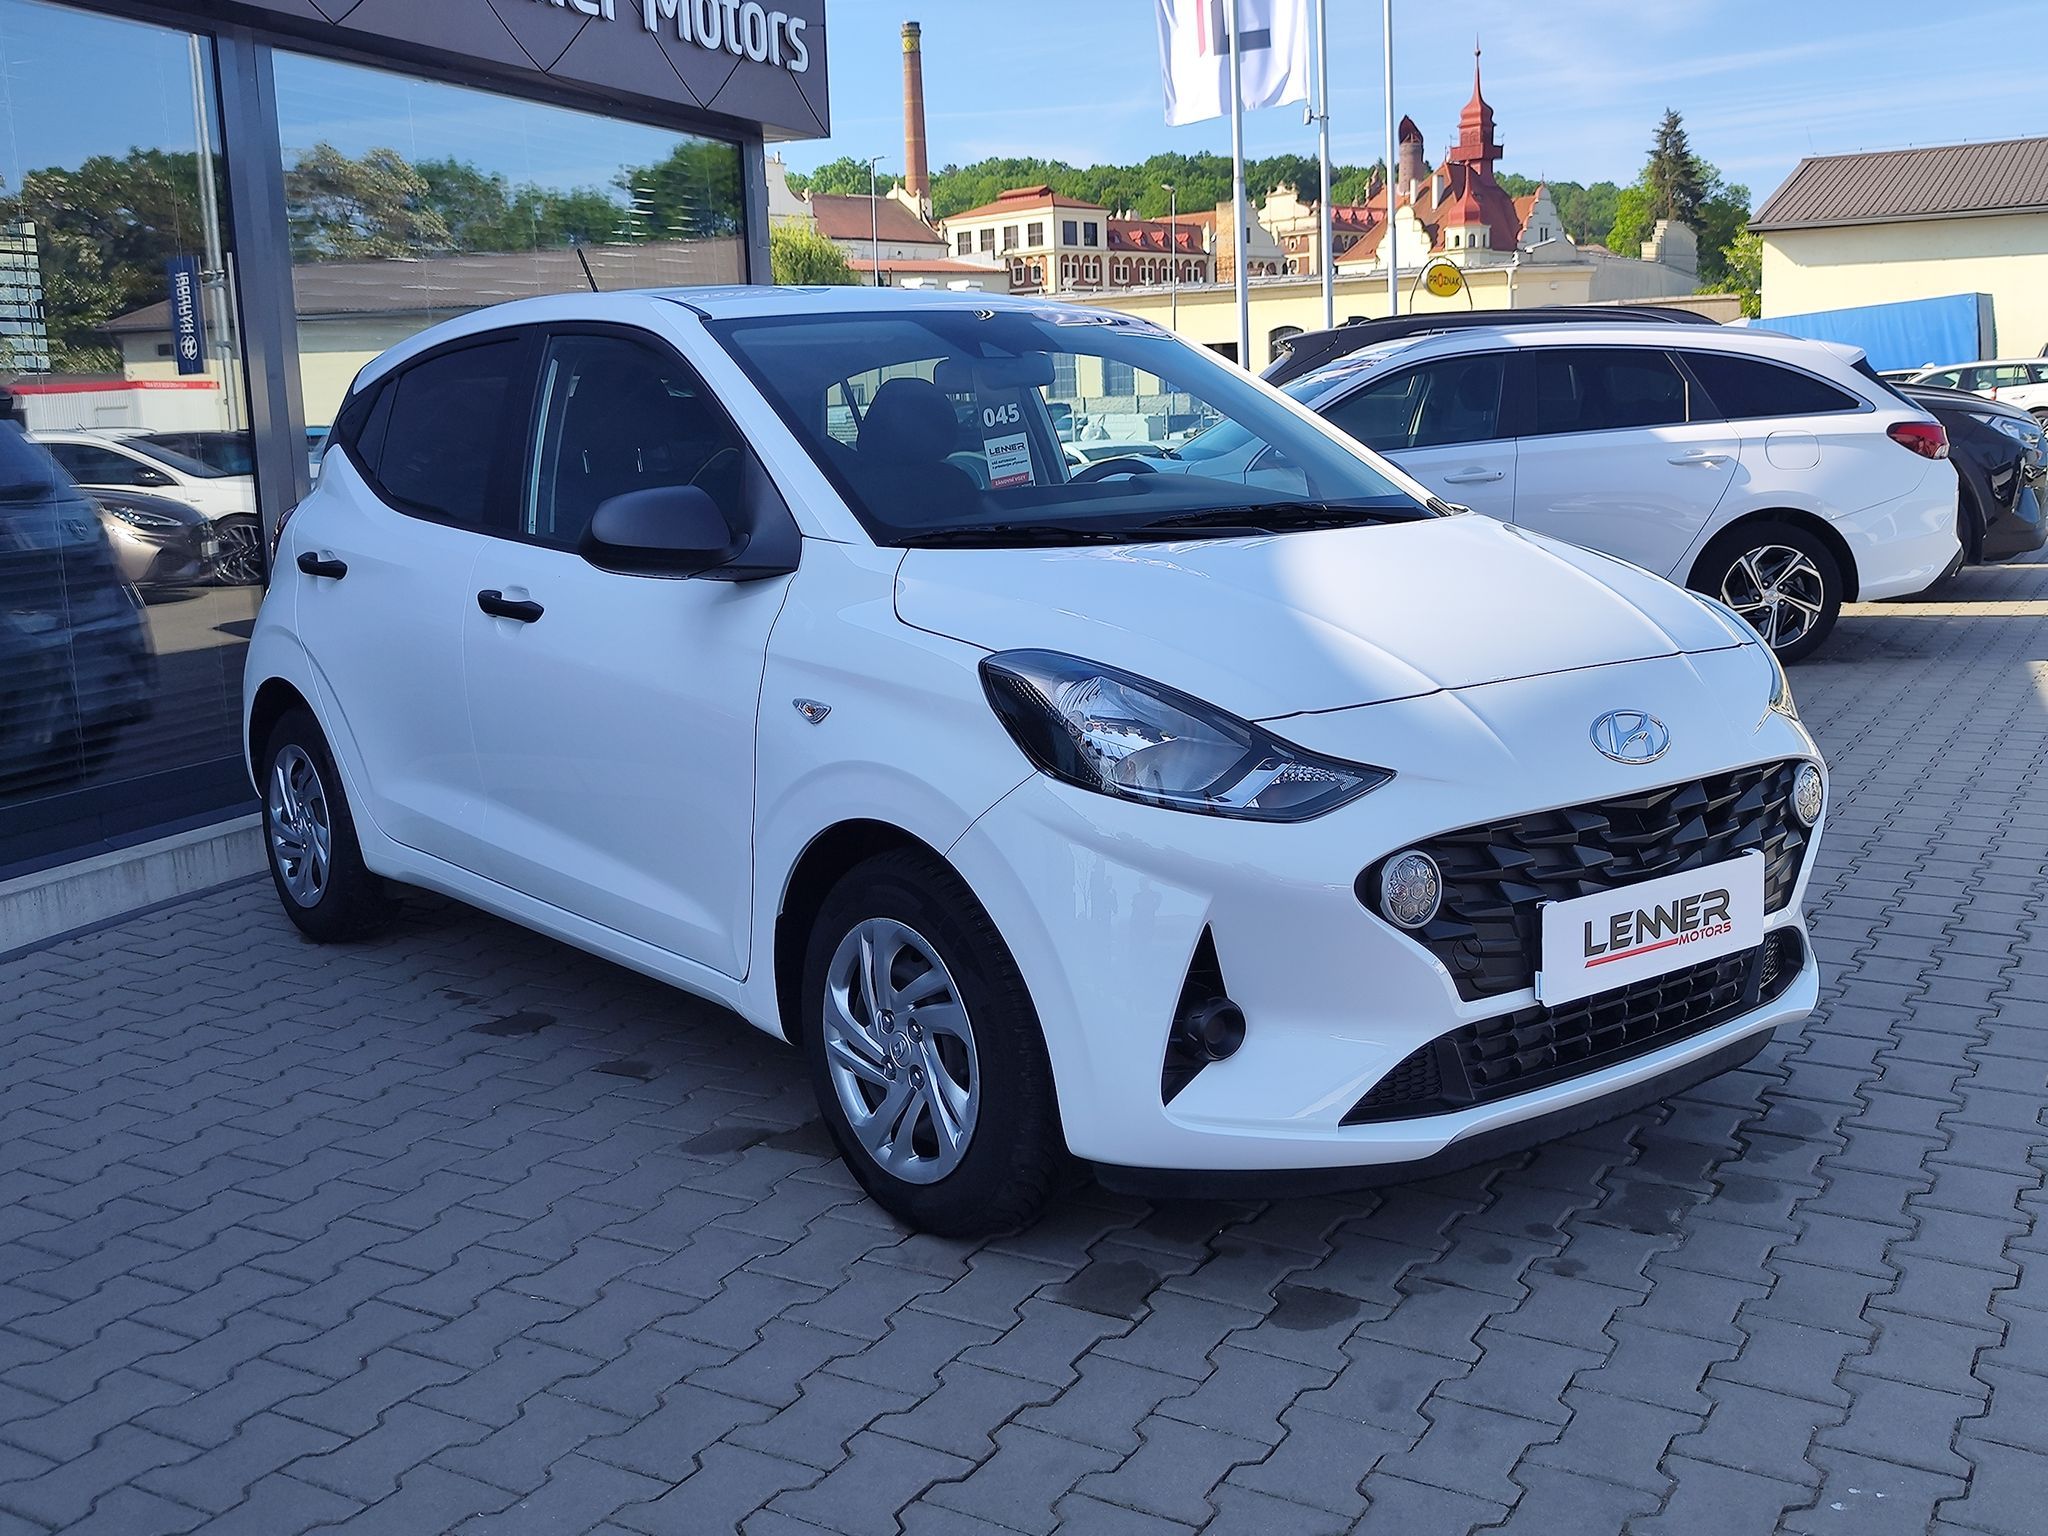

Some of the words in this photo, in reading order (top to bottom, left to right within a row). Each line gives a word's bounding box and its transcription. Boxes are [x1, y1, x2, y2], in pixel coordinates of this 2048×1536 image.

[643, 0, 810, 73] Motors
[983, 403, 1020, 428] 045
[989, 443, 1025, 455] LENNER
[1584, 888, 1732, 958] LENNER
[1679, 920, 1732, 946] MOTORS
